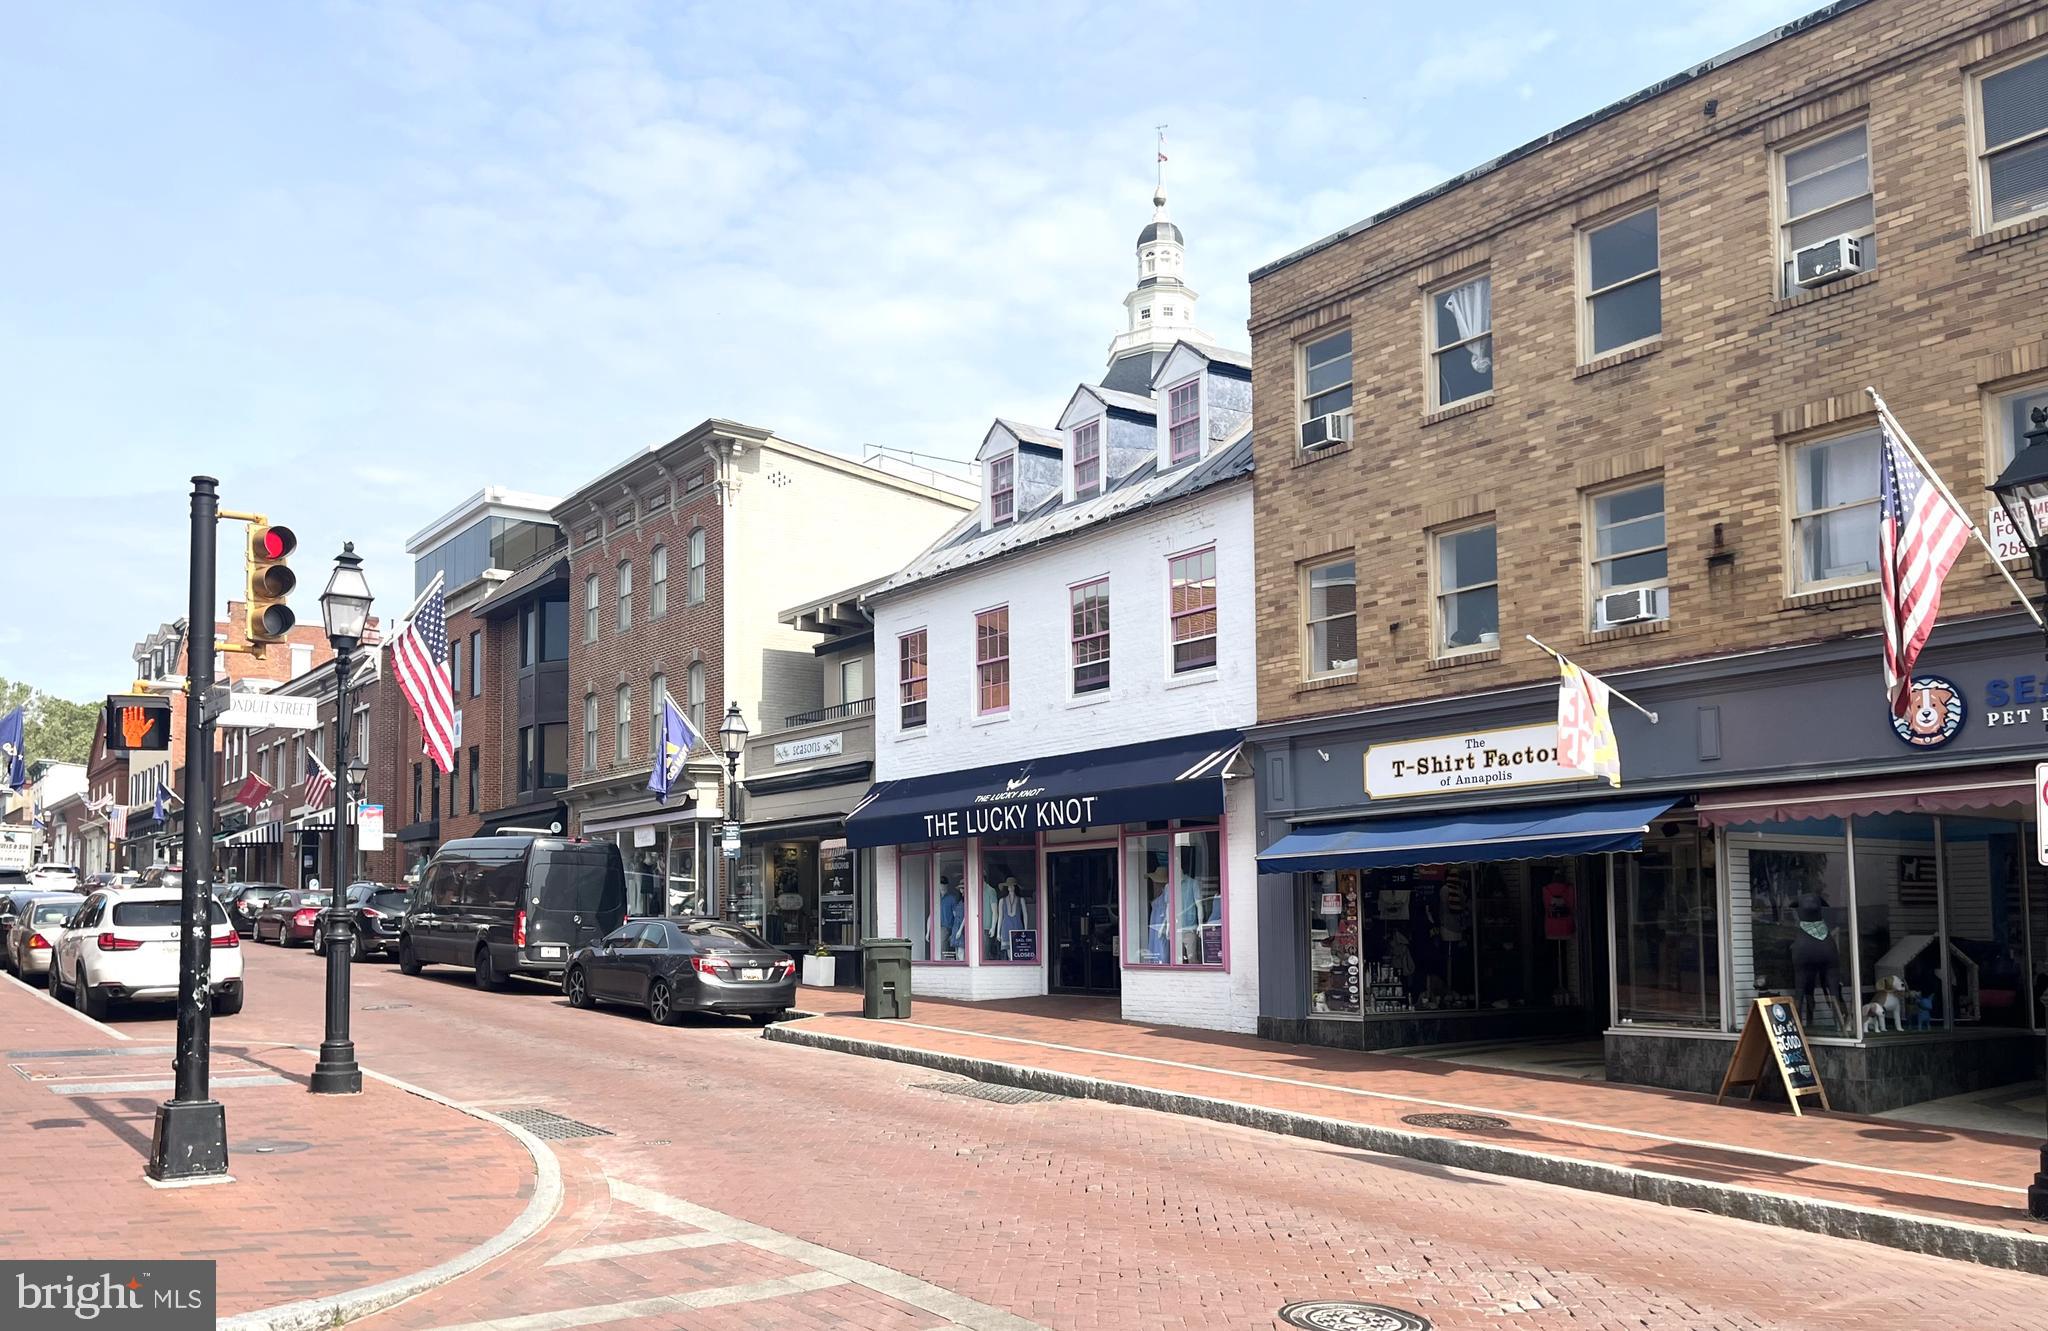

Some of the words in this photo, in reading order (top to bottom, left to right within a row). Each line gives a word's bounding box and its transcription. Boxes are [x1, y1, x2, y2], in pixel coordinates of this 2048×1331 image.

[1985, 674, 2048, 707] SE
[230, 698, 270, 714] ONDUIT
[272, 701, 312, 717] STREET
[1987, 709, 2031, 727] PET
[792, 742, 821, 756] seasons
[1465, 738, 1485, 749] The
[1392, 752, 1475, 778] T-Shirt
[1483, 746, 1558, 768] Factor
[1440, 776, 1451, 787] of
[1455, 770, 1513, 786] Annapolis
[974, 795, 990, 803] THE
[990, 790, 1019, 801] LUCKY
[1019, 787, 1042, 797] KNOT
[924, 812, 960, 837] THE
[966, 804, 1028, 834] LUCKY
[1036, 796, 1095, 827] KNOT
